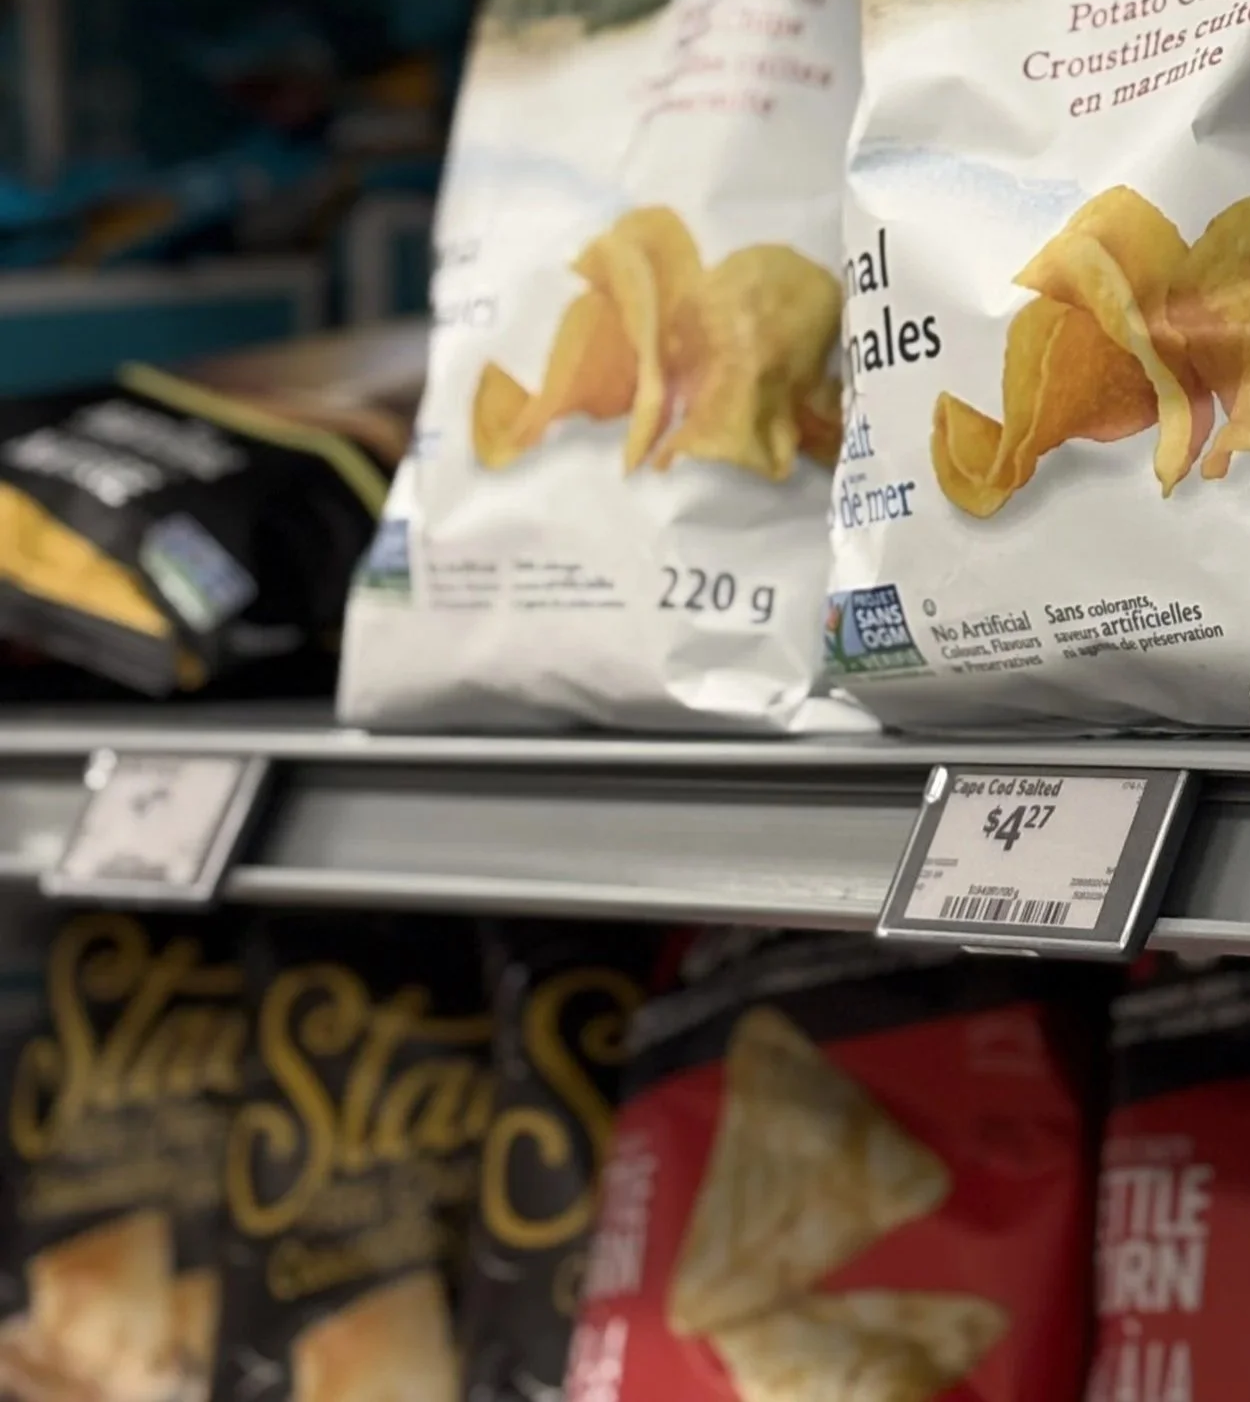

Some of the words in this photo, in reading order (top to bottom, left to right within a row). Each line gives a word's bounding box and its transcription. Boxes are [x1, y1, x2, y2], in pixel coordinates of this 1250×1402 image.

[1022, 27, 1188, 81] Croustilles
[1069, 93, 1102, 118] en
[1111, 44, 1224, 107] marmite
[865, 480, 915, 524] mer
[658, 566, 737, 613] 220
[751, 585, 775, 625] g
[1044, 602, 1085, 625] Sans
[1088, 595, 1154, 618] colorants,
[931, 625, 959, 643] No
[962, 610, 1032, 640] Artificial
[1053, 627, 1100, 645] saveurs
[1101, 601, 1203, 638] artificielles
[1120, 636, 1138, 652] de
[1138, 623, 1224, 653] préservation
[952, 778, 985, 798] Cape
[987, 778, 1015, 797] Cod
[1016, 779, 1064, 798] Salted
